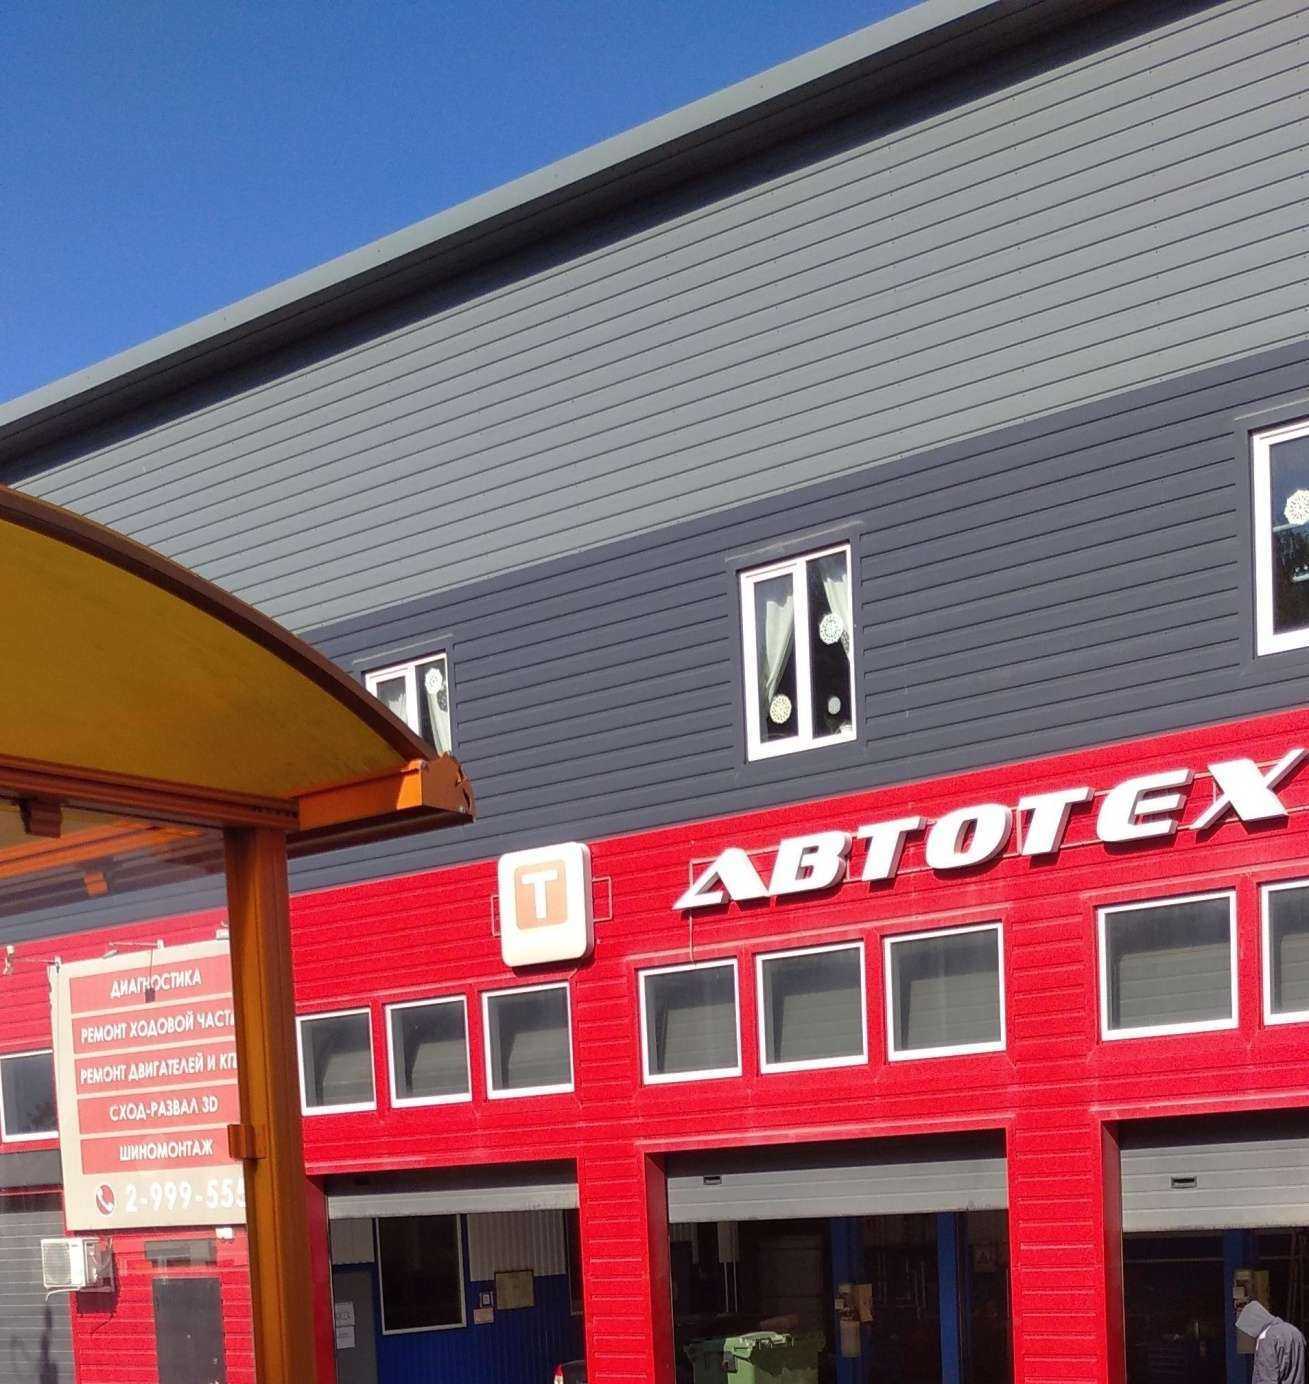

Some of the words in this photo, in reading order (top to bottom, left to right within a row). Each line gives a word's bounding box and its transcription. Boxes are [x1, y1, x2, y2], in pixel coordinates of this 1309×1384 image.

[673, 747, 1309, 911] АВТОТЕХ
[110, 968, 202, 998] ДИАГНОСТИКА
[80, 1022, 127, 1043] РЕМОНТ
[130, 1010, 194, 1037] ХОДОВОЙ
[80, 1065, 127, 1084] РЕМОНТ
[128, 1051, 204, 1081] ДВИГАТЕЛЕЙ
[207, 1053, 216, 1071] И
[109, 1096, 199, 1121] СХОД-РАЗВАЛ
[202, 1094, 218, 1113] 3D
[119, 1138, 214, 1162] ШИНОМОНТАЖ
